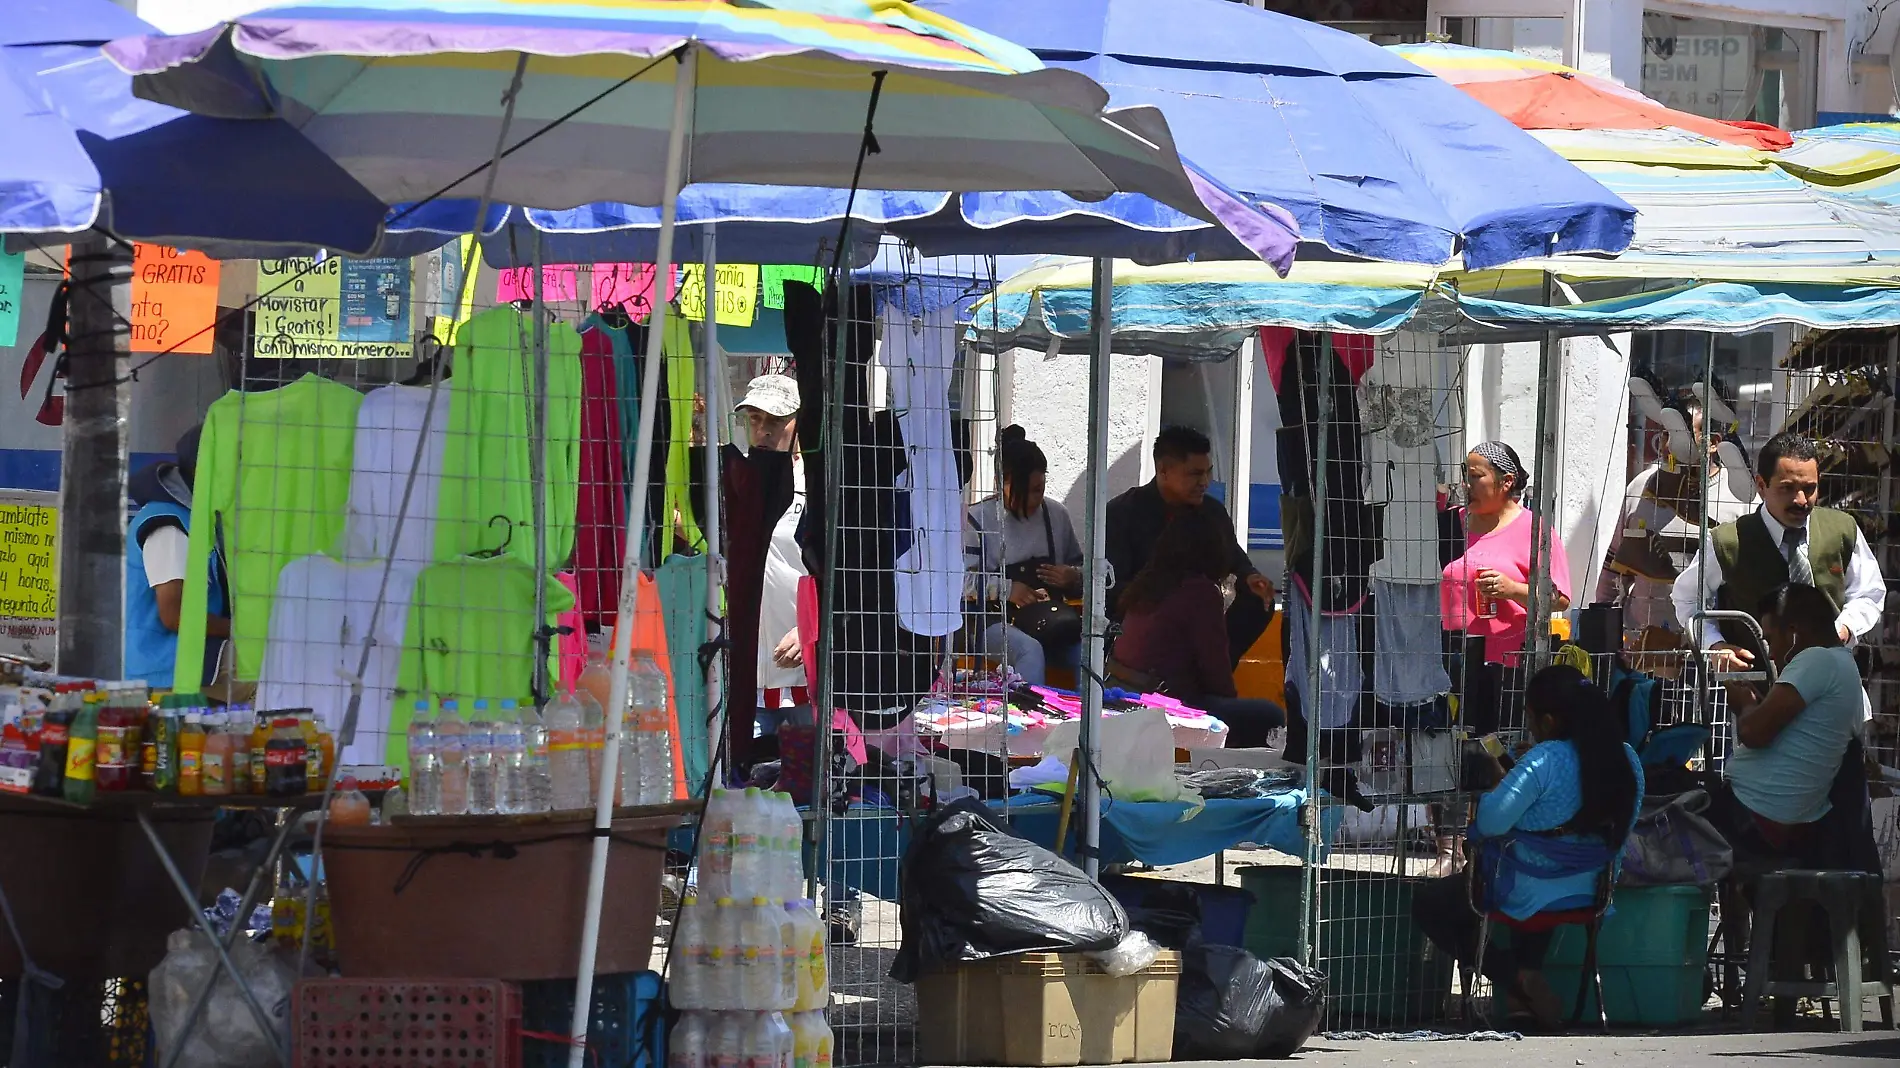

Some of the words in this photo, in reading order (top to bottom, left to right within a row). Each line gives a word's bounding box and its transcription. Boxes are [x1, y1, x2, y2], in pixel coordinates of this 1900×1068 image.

[142, 263, 206, 285] GRATIS
[294, 279, 305, 292] a
[257, 297, 329, 313] Movistar
[4, 527, 39, 546] mismo
